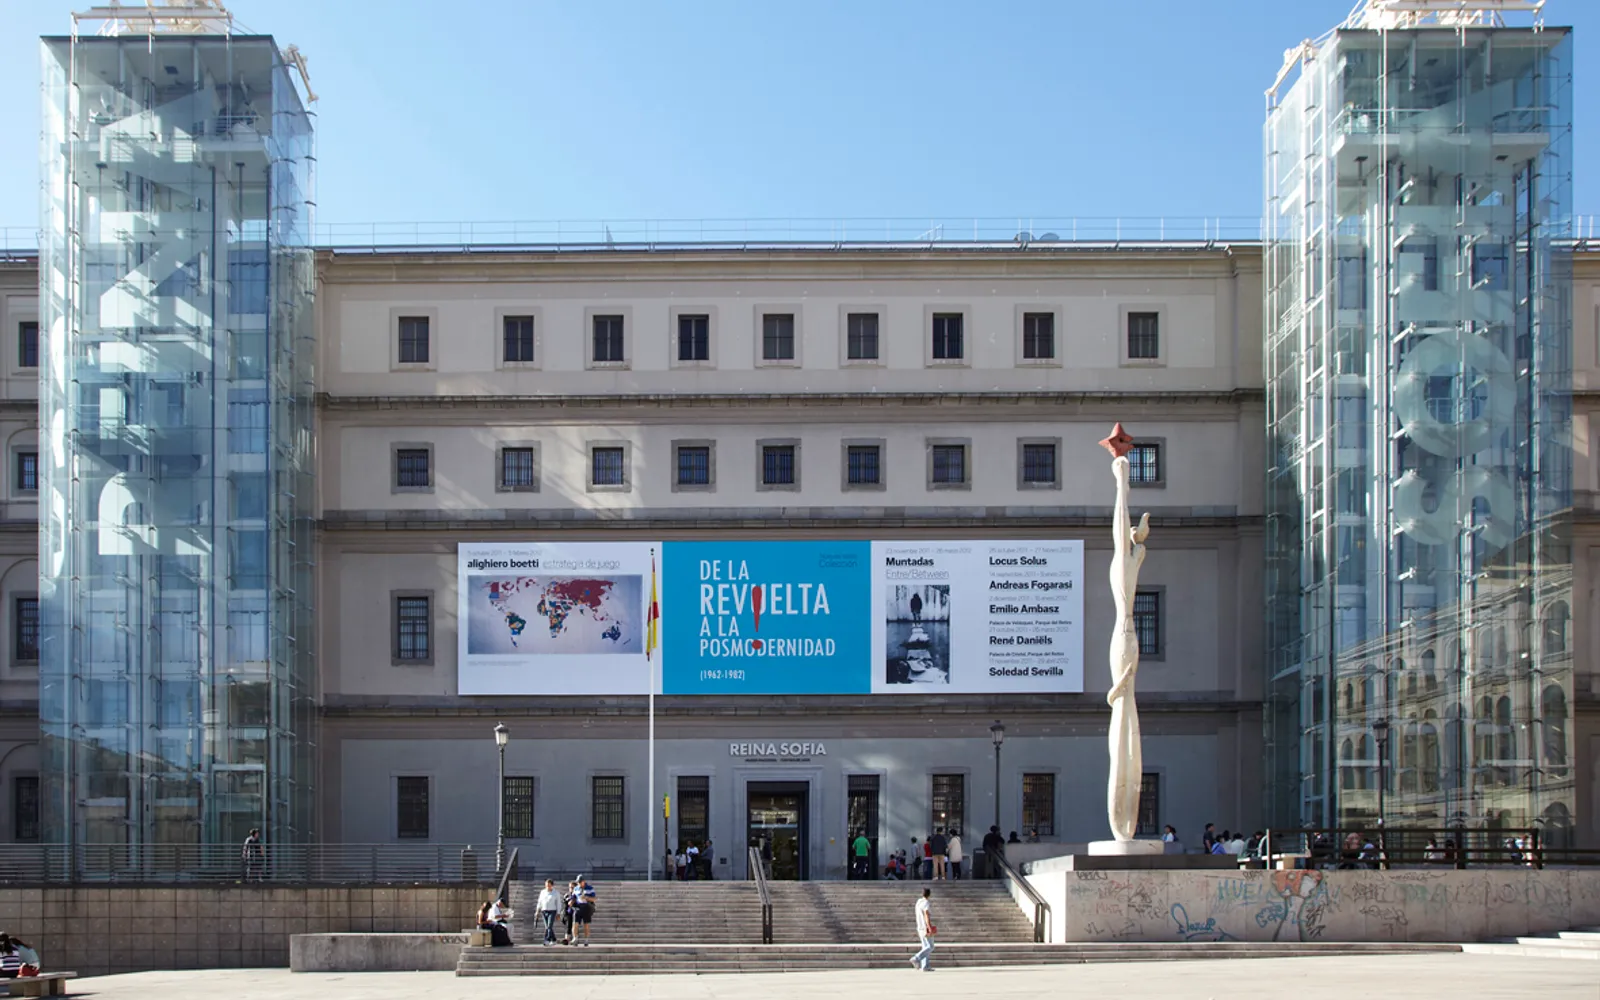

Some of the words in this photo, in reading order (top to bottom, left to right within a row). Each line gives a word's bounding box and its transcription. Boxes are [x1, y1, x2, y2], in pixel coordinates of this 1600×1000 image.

[467, 558, 508, 570] alighiero
[510, 558, 540, 568] boetti
[886, 557, 934, 567] Muntadas
[989, 556, 1018, 566] Locus
[1020, 556, 1047, 566] Solus
[700, 560, 721, 580] DE
[728, 560, 750, 580] LA
[989, 580, 1029, 590] Andreas
[1031, 580, 1072, 591] Fogarasi
[700, 583, 830, 615] REVUELTA
[989, 604, 1018, 614] Emilio
[1020, 604, 1060, 614] Ambasz
[699, 616, 711, 636] A
[718, 616, 740, 636] LA
[989, 635, 1014, 645] René
[1016, 635, 1052, 645] Daniëls
[700, 638, 836, 657] POSMODERNIDAD
[989, 667, 1029, 677] Soledad
[1031, 667, 1064, 677] Sevilla
[730, 743, 777, 755] REINA
[780, 743, 827, 755] SOFIA
